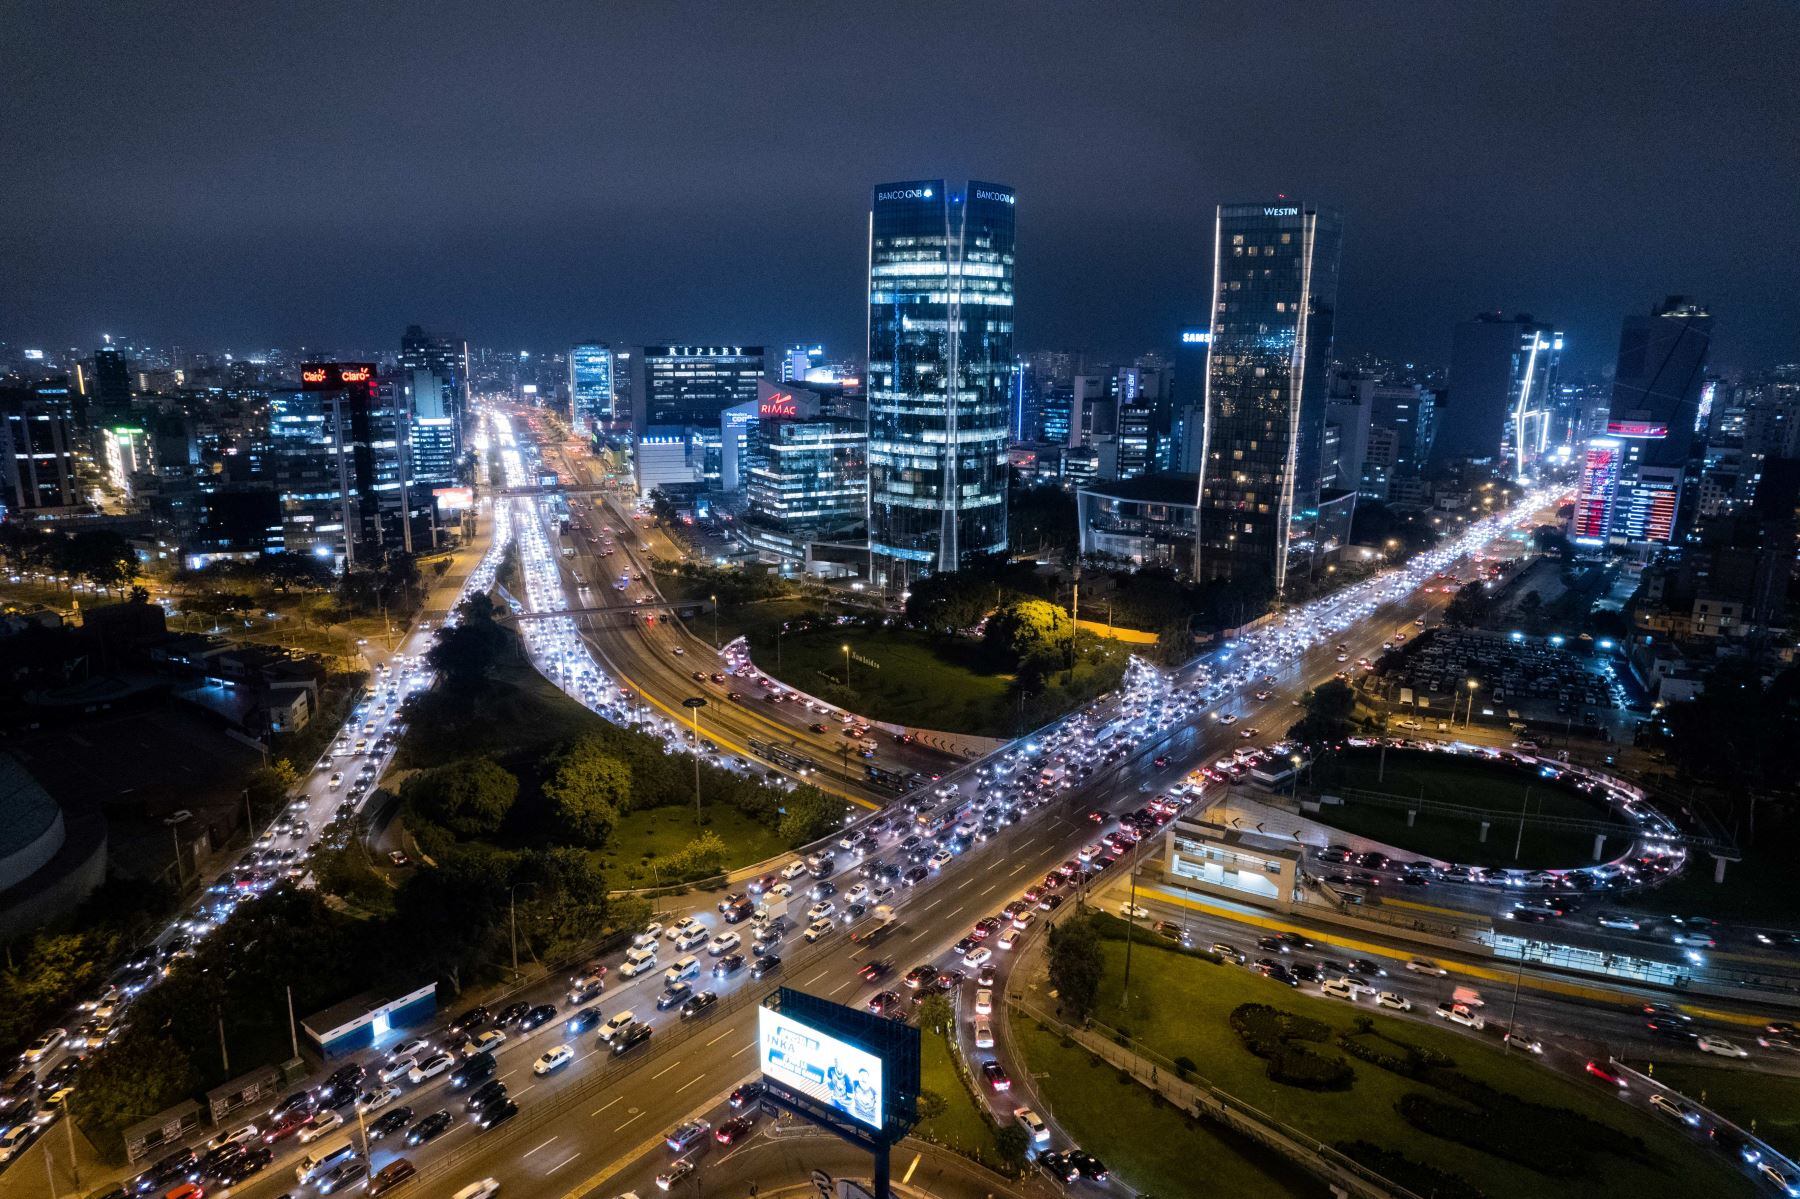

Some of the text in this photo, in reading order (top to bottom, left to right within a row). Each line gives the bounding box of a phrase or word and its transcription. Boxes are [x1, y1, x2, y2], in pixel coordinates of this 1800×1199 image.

[878, 189, 922, 201] BANCO GNB
[976, 190, 1000, 201] BANCO
[1264, 207, 1298, 216] WESTIN
[669, 347, 743, 356] RIPLEY
[303, 370, 324, 382] Claro
[341, 370, 366, 382] Claro
[761, 404, 796, 415] RIMAC
[643, 436, 680, 444] RIPLEY
[767, 1034, 794, 1052] INKA
